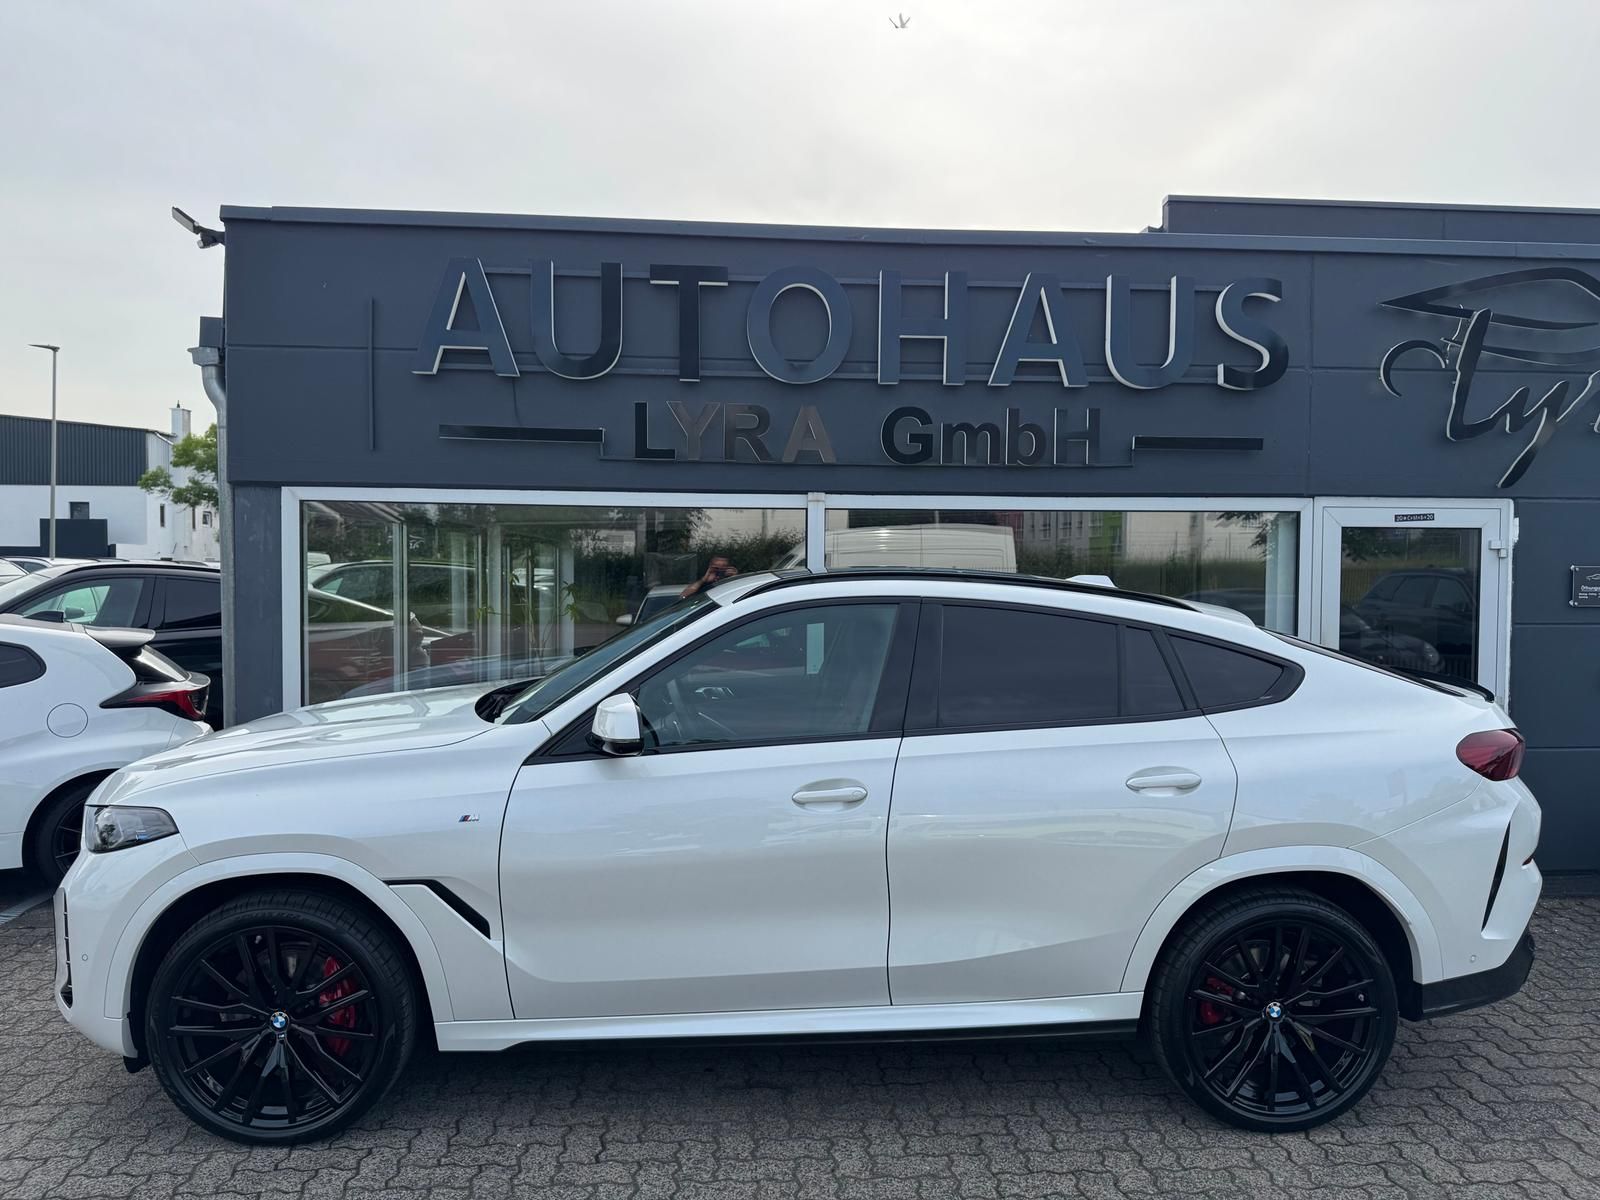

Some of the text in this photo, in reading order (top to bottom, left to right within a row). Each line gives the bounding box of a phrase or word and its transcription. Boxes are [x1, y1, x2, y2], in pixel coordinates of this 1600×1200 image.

[411, 256, 1290, 392] AUTOHAUS
[634, 401, 1102, 467] LYRA GmbH
